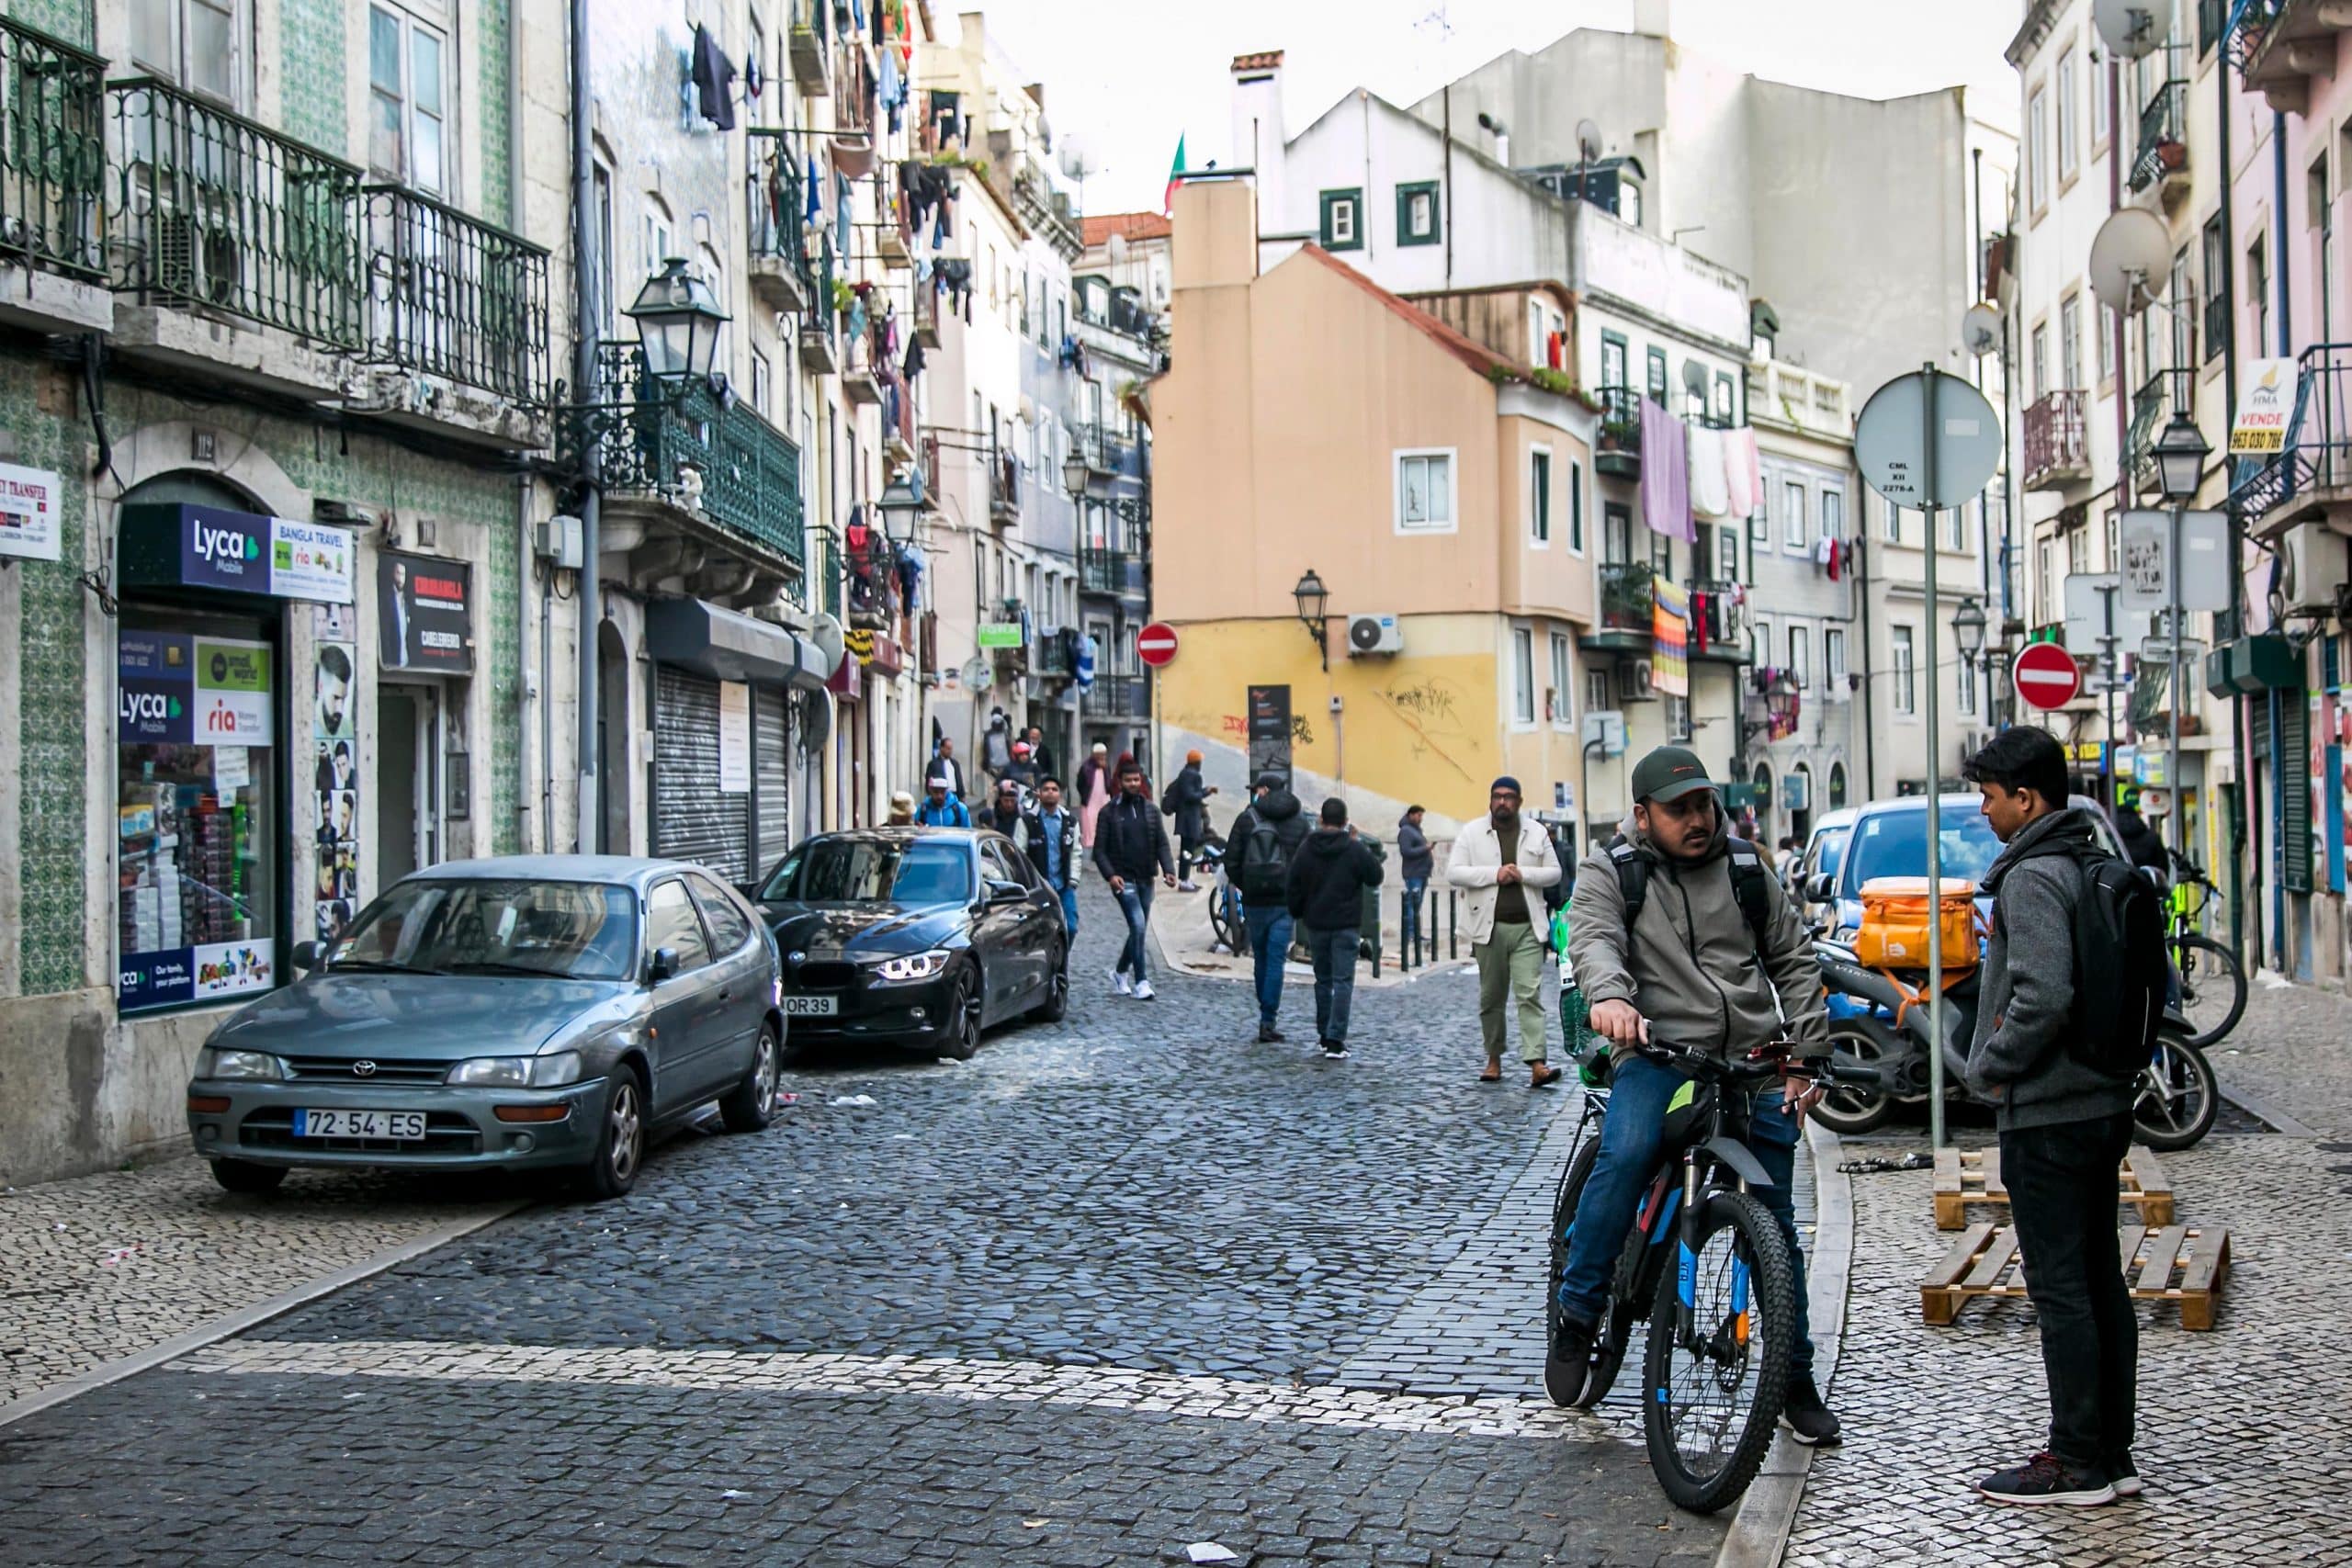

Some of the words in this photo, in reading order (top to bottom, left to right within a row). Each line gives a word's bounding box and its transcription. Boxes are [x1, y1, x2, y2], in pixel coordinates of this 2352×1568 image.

[2241, 412, 2282, 425] VENDE
[2232, 433, 2248, 449] 963
[2249, 433, 2267, 449] 030
[1888, 462, 1908, 470] CML
[9, 480, 47, 501] TRANSFER
[194, 519, 244, 561] Lyca
[279, 525, 313, 543] BANGLA
[315, 531, 344, 548] TRAVEL
[119, 686, 167, 724] Lyca
[209, 698, 236, 732] ria
